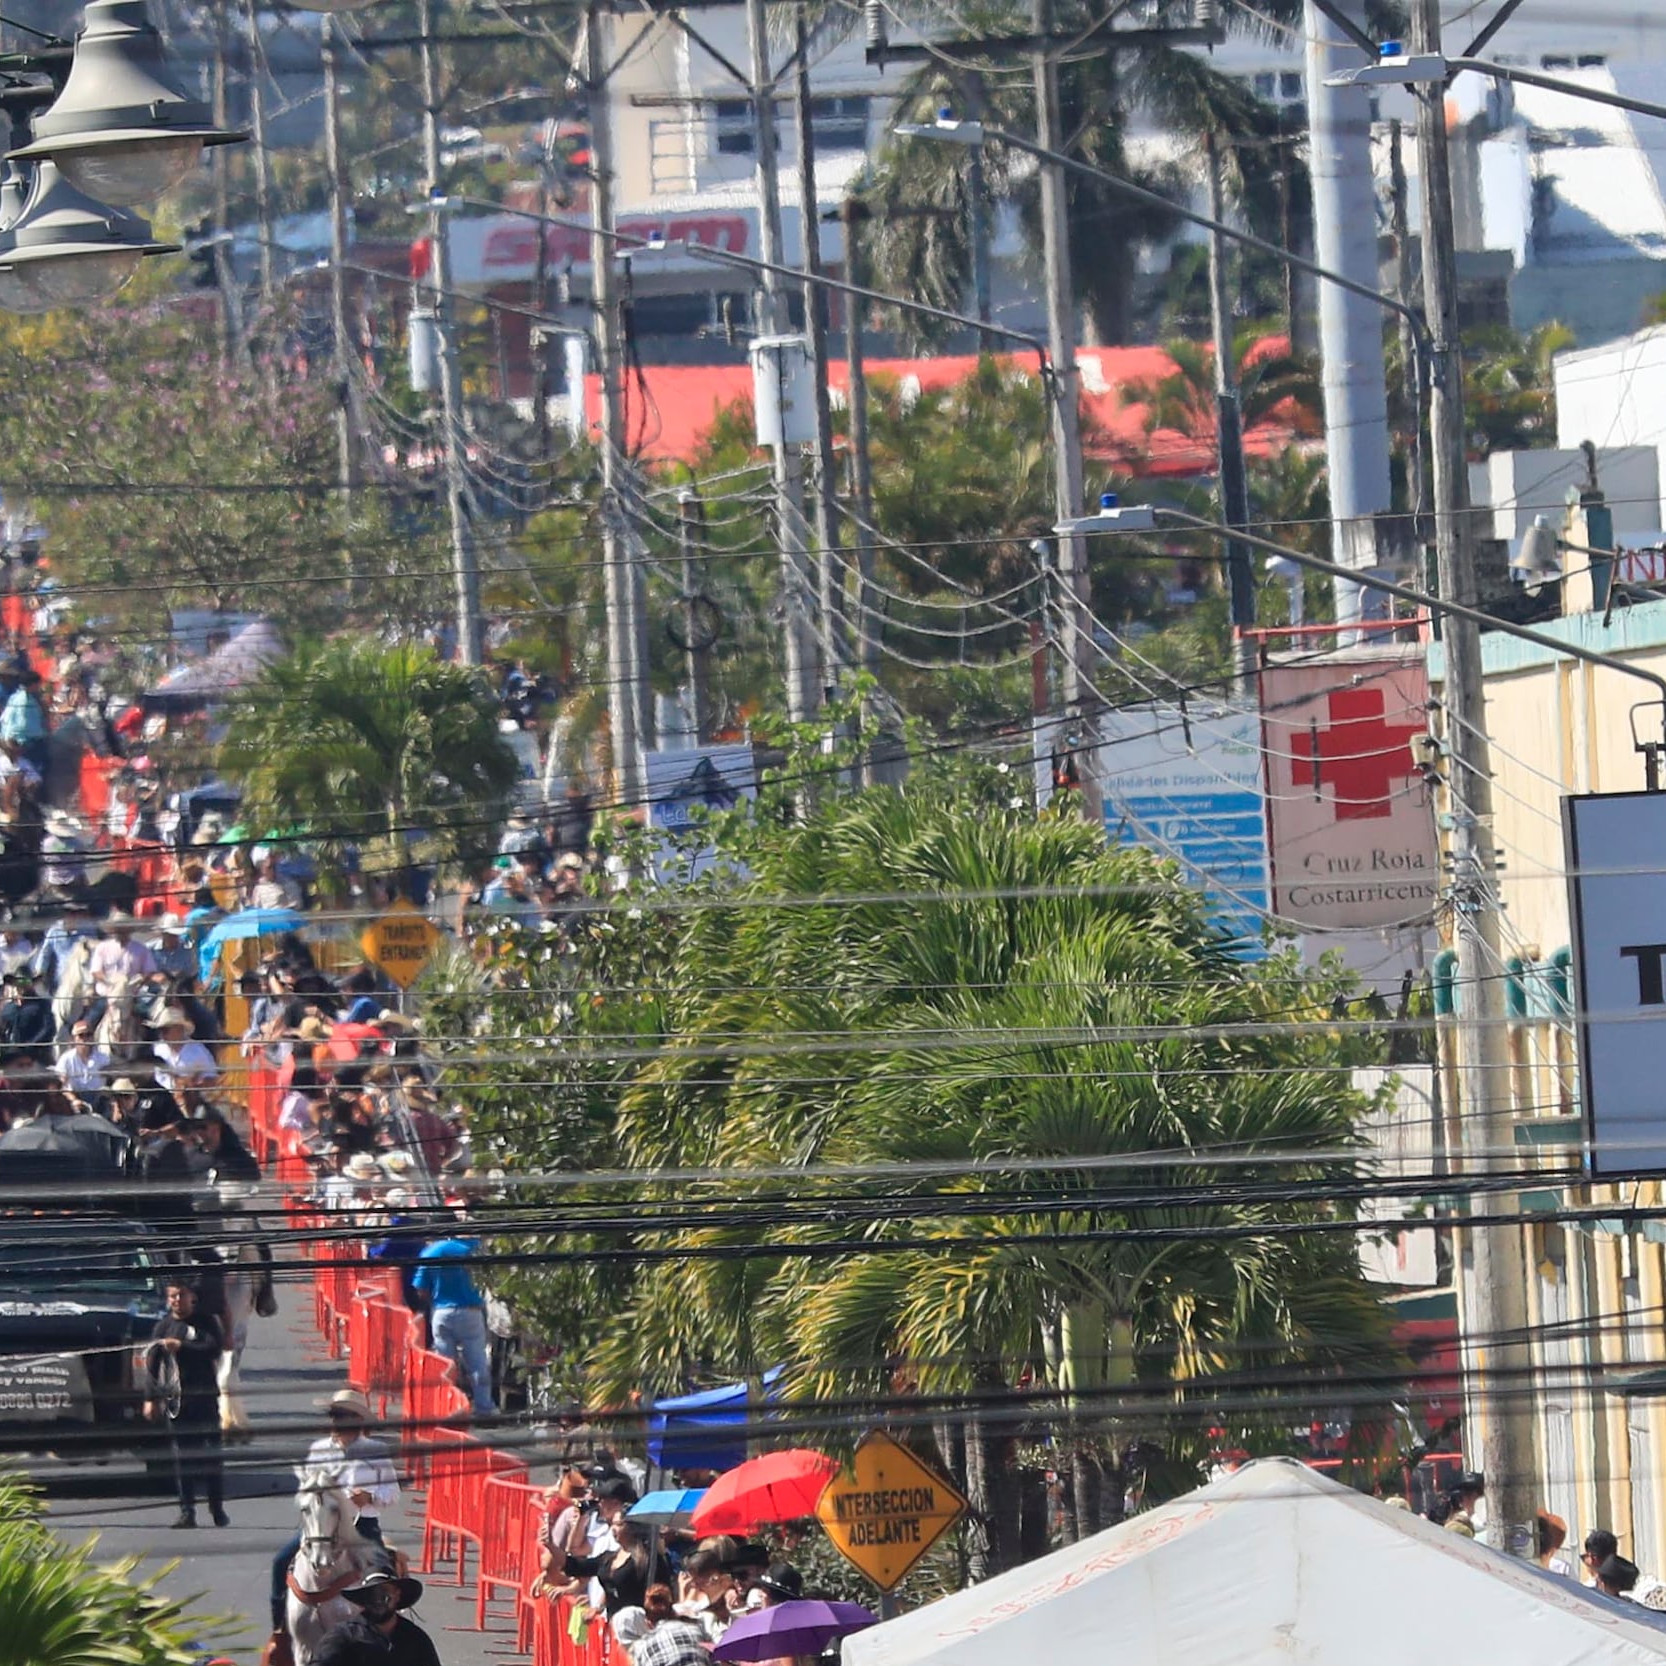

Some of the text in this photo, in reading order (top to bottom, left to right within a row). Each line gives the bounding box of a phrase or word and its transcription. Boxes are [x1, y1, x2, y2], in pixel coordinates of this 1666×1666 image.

[1303, 848, 1425, 876] Cruz Roja
[1289, 881, 1436, 908] Costarricens
[849, 1520, 920, 1546] ADELANTE
